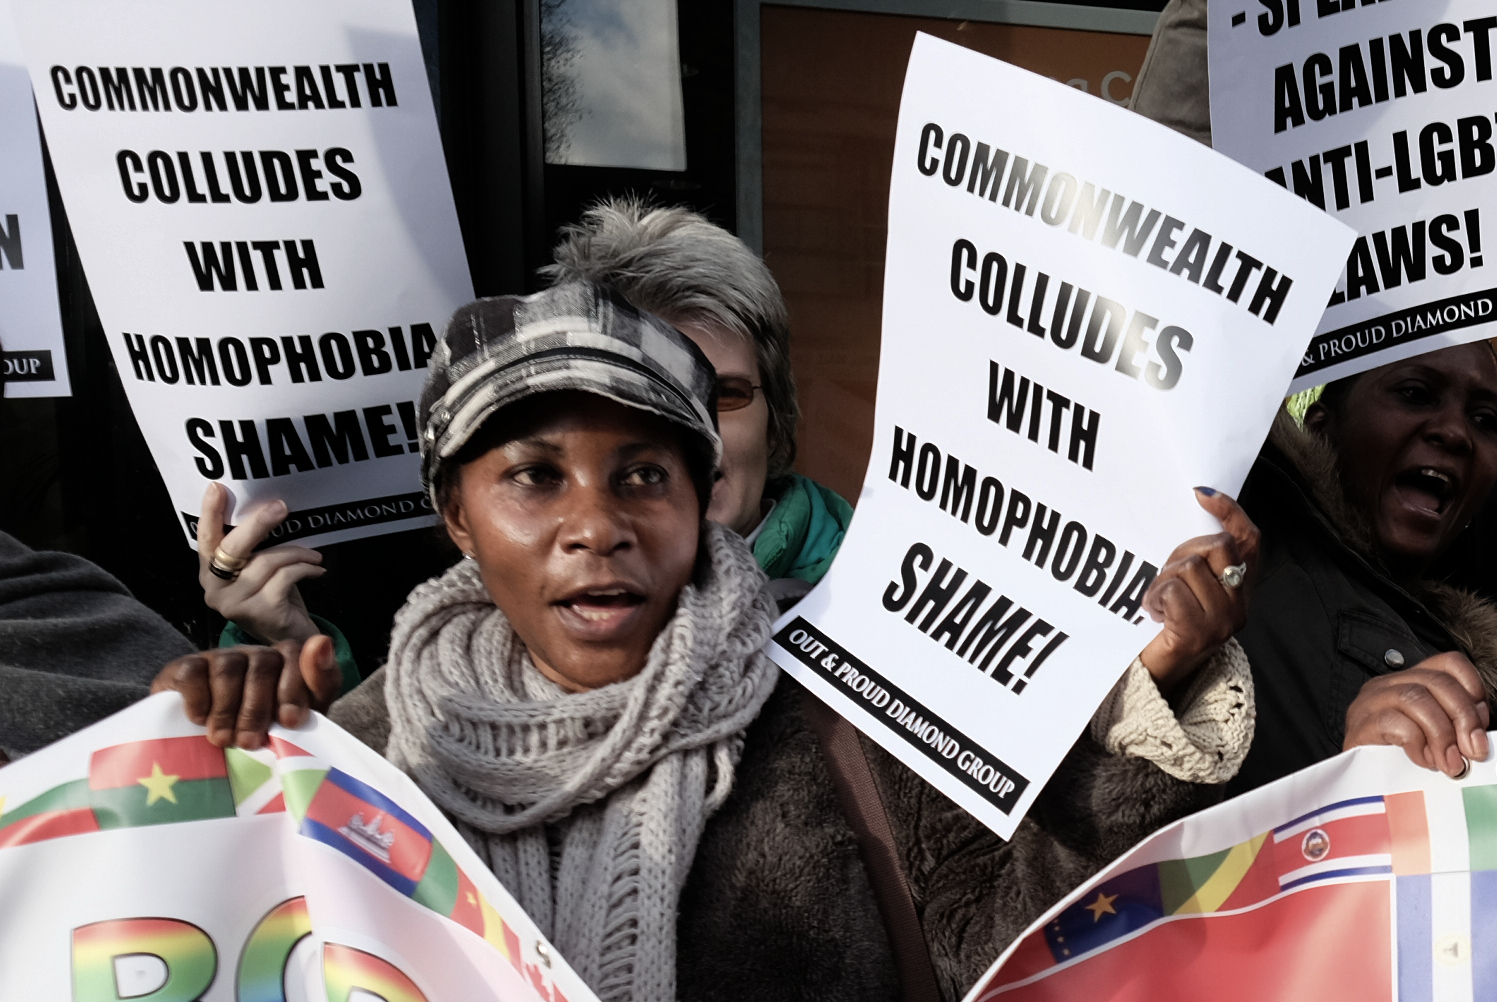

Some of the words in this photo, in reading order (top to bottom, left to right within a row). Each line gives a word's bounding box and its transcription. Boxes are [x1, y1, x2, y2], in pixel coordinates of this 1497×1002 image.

[50, 62, 399, 113] COMMONWEALTH
[1273, 15, 1497, 134] AGAINST
[115, 147, 363, 205] COLLUDES
[917, 122, 1294, 327] COMMONWEALTH
[183, 239, 325, 292] WITH
[1327, 208, 1486, 308] AWS!
[950, 238, 1194, 392] COLLUDES
[1318, 325, 1386, 361] PROUD
[1391, 298, 1493, 338] DIAMOND
[185, 400, 419, 481] SHAME!
[987, 359, 1101, 473] WITH
[308, 499, 415, 529] DIAMOND
[882, 542, 1070, 696] SHAME!
[788, 628, 829, 661] OUT
[820, 653, 837, 672] &
[834, 661, 891, 709] PROUD
[885, 698, 960, 759] DIAMOND
[957, 750, 1015, 799] GROUP
